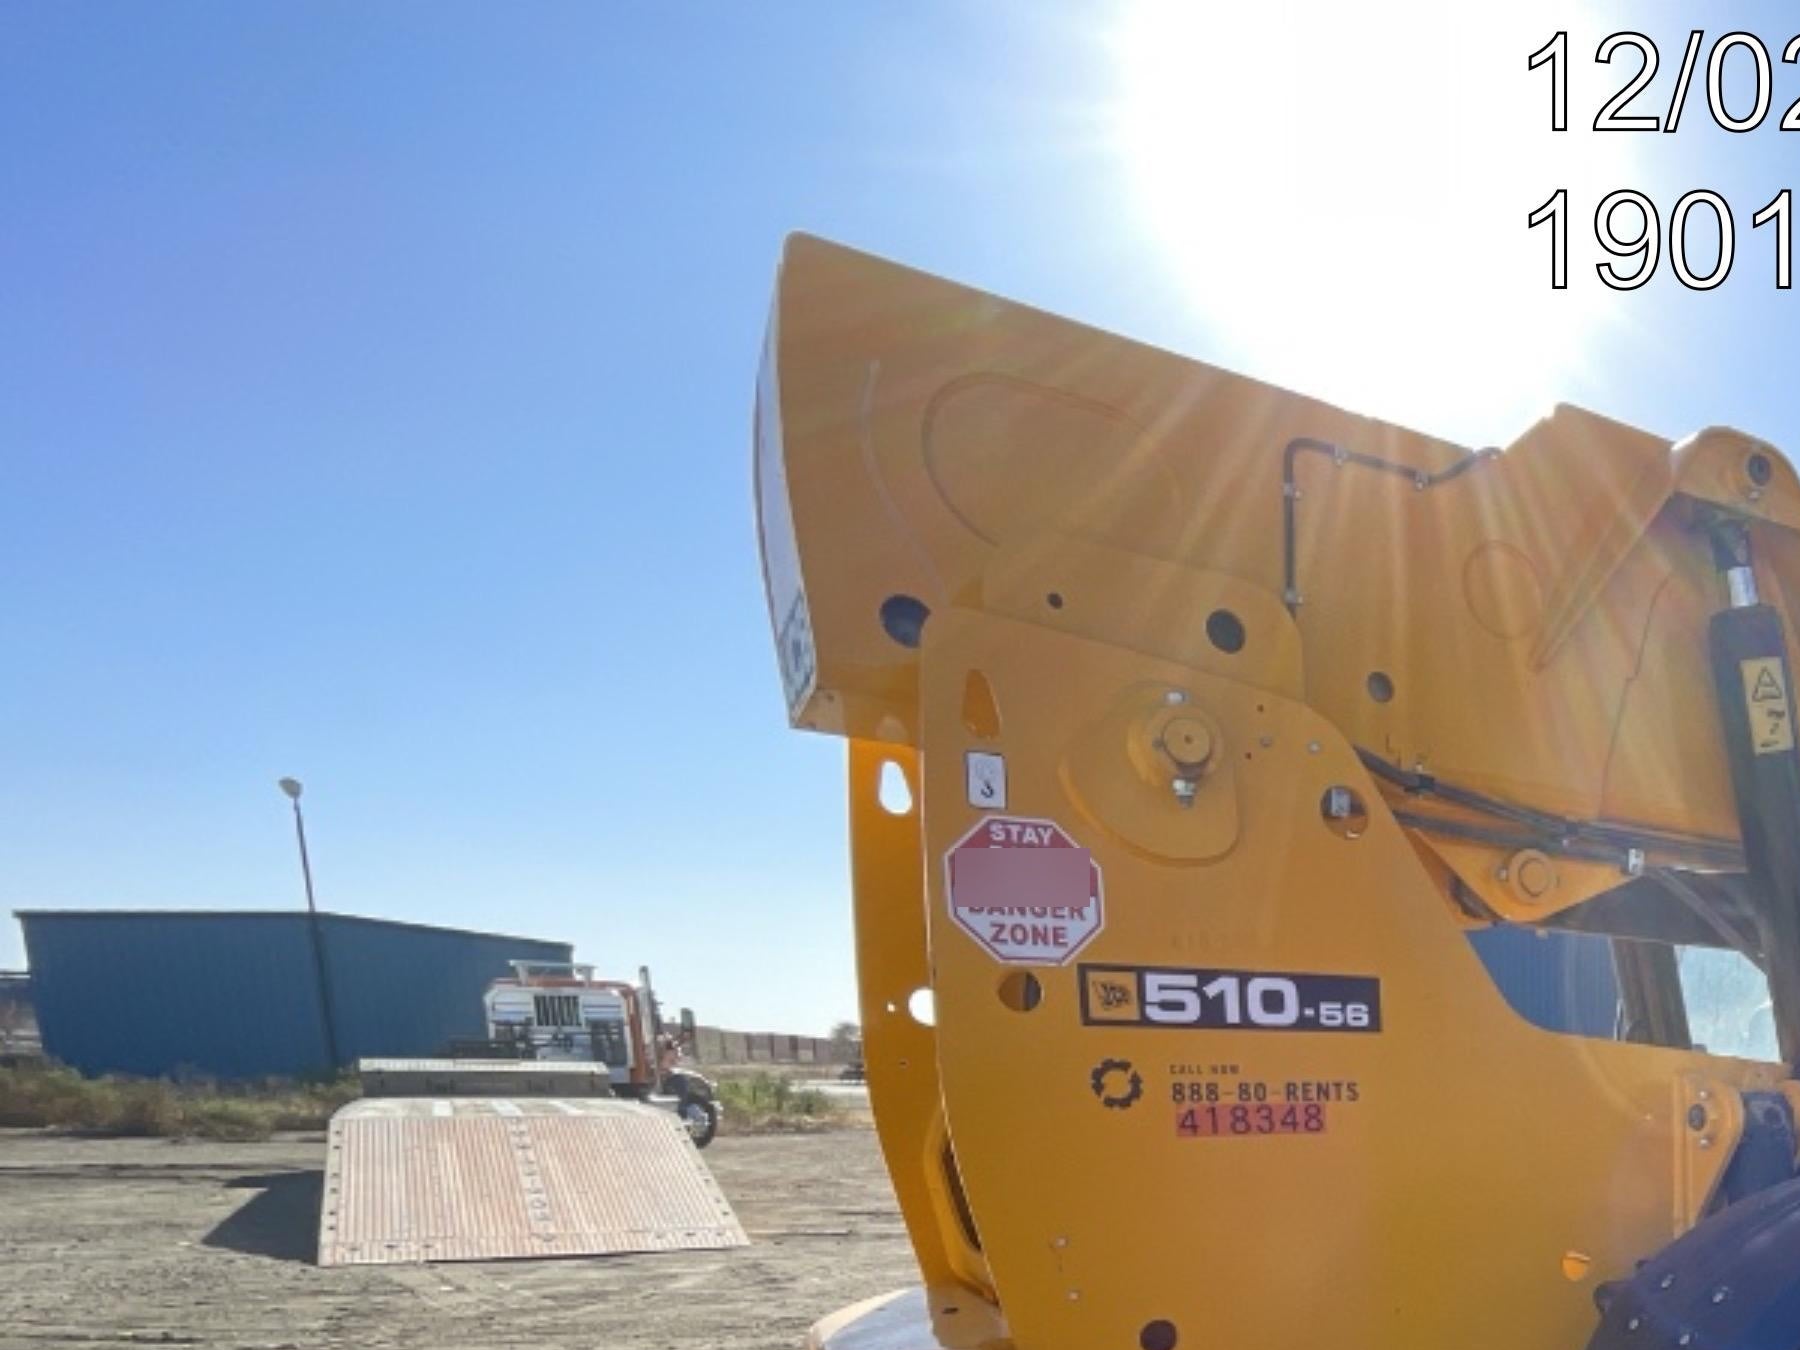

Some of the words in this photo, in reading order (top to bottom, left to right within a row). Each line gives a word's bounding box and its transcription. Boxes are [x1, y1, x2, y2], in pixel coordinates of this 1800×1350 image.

[989, 822, 1053, 846] STAY
[989, 921, 1070, 949] ZONE
[1178, 1102, 1325, 1138] 418348
